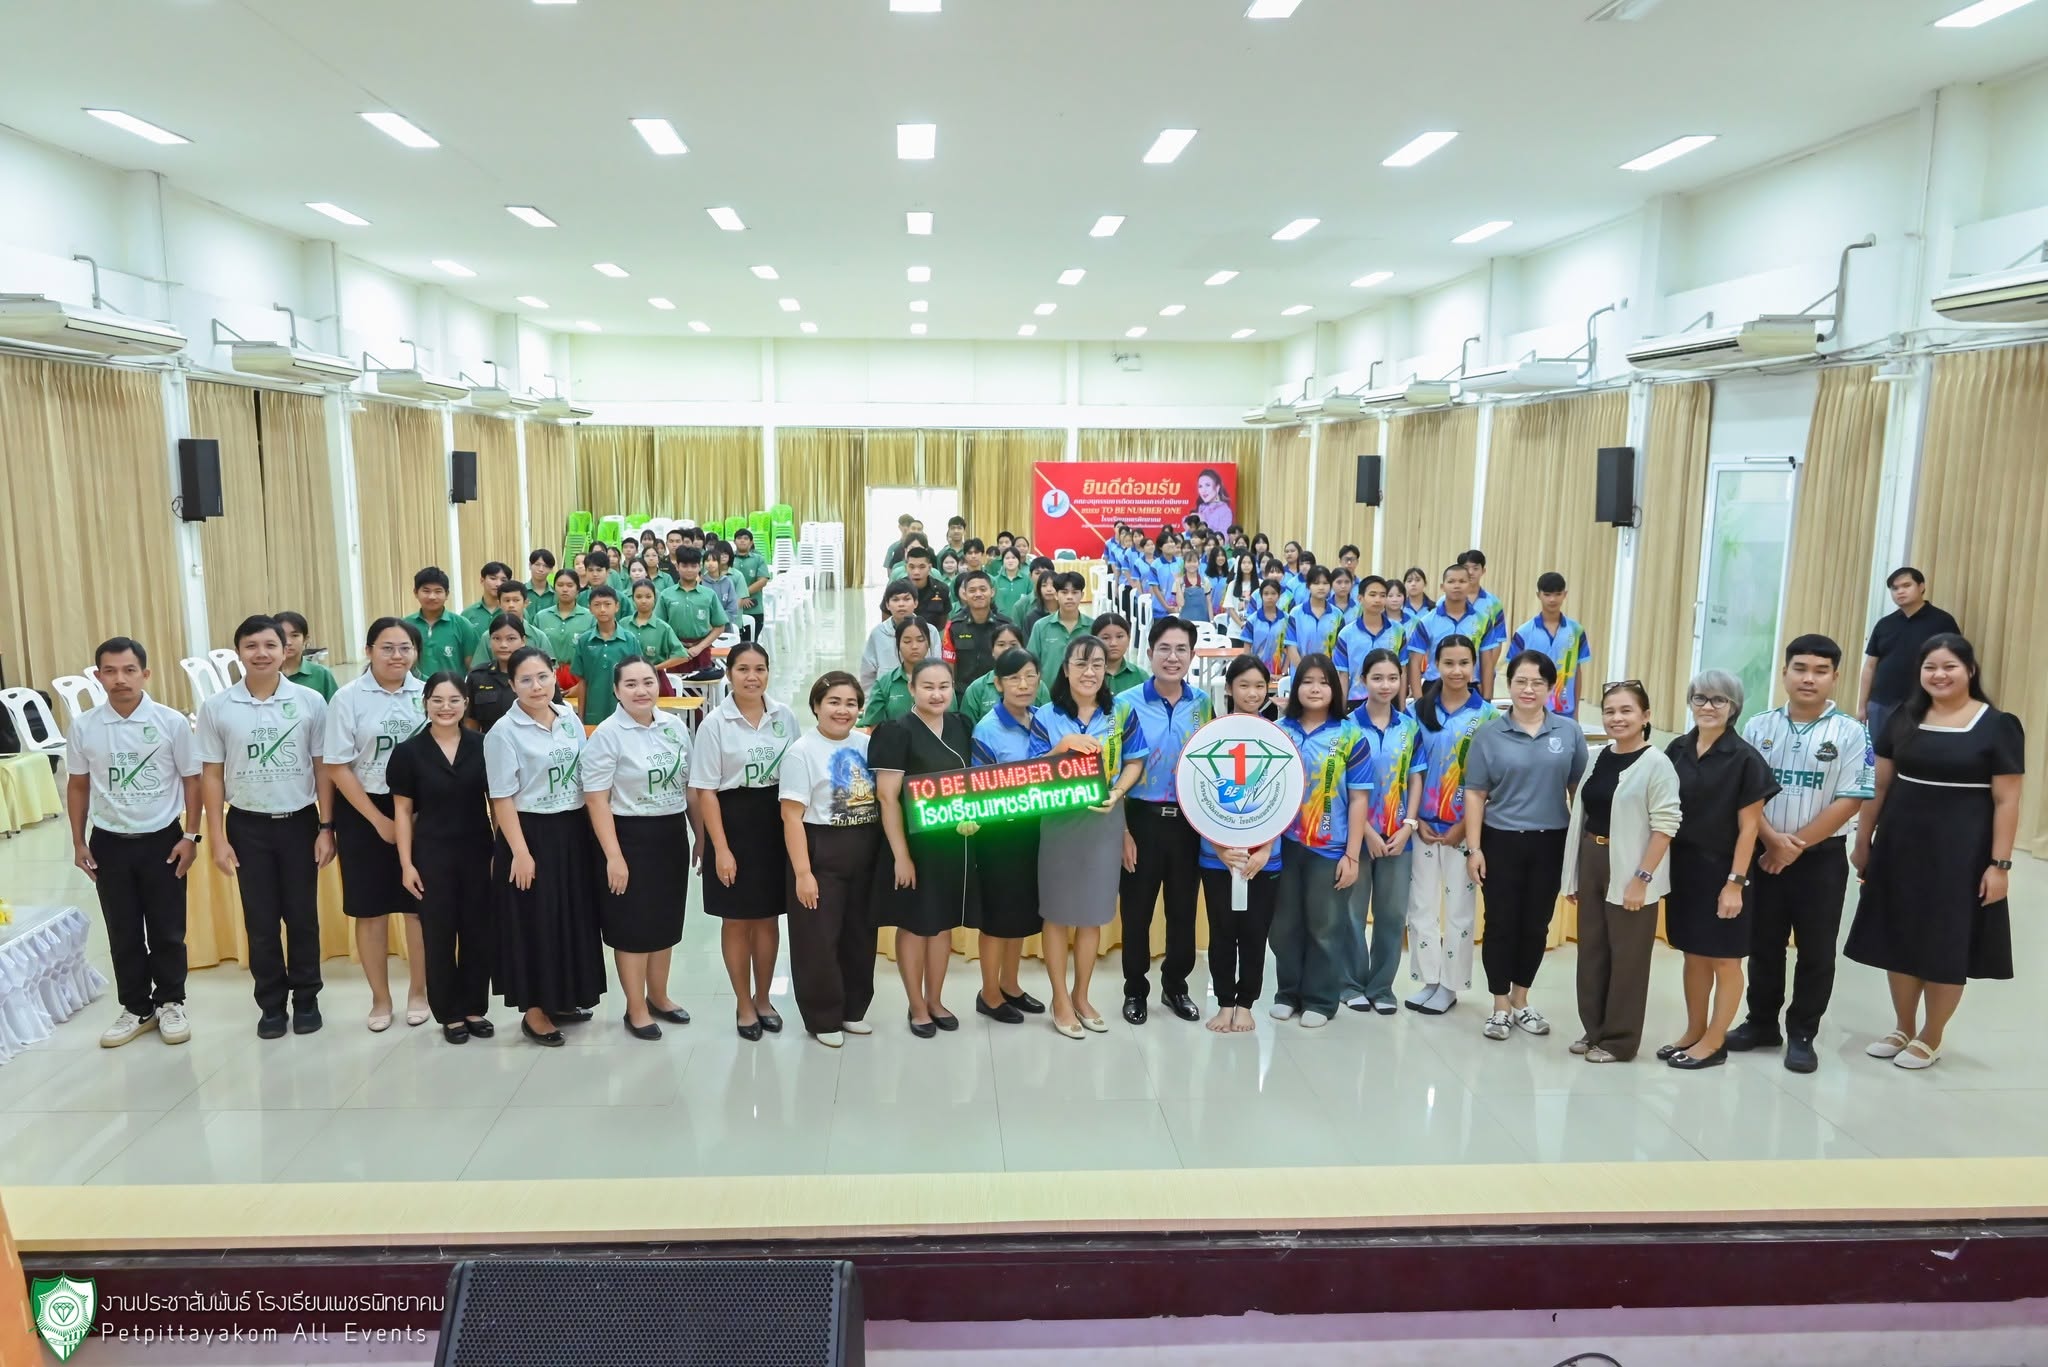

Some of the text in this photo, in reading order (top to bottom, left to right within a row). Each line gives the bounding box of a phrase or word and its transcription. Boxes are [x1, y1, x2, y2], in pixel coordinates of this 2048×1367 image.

[1083, 477, 1181, 496] ยินดีต้อนรับ
[1102, 506, 1114, 515] TO
[1115, 506, 1126, 515] BE
[1127, 506, 1162, 515] NUMBER
[1163, 506, 1182, 515] ONE
[251, 727, 279, 742] 125
[380, 719, 413, 735] 125
[110, 752, 139, 766] 125
[548, 746, 575, 766] 125
[646, 751, 675, 768] 125
[747, 746, 776, 762] 125
[1228, 743, 1246, 786] 1
[908, 778, 937, 800] TO
[941, 774, 967, 797] BE
[970, 762, 1053, 792] NUMBER
[1057, 755, 1100, 780] ONE
[1224, 785, 1240, 798] BE
[916, 783, 1100, 827] โรงเรียนเพชรพิทยาคม
[1322, 814, 1331, 831] PKS
